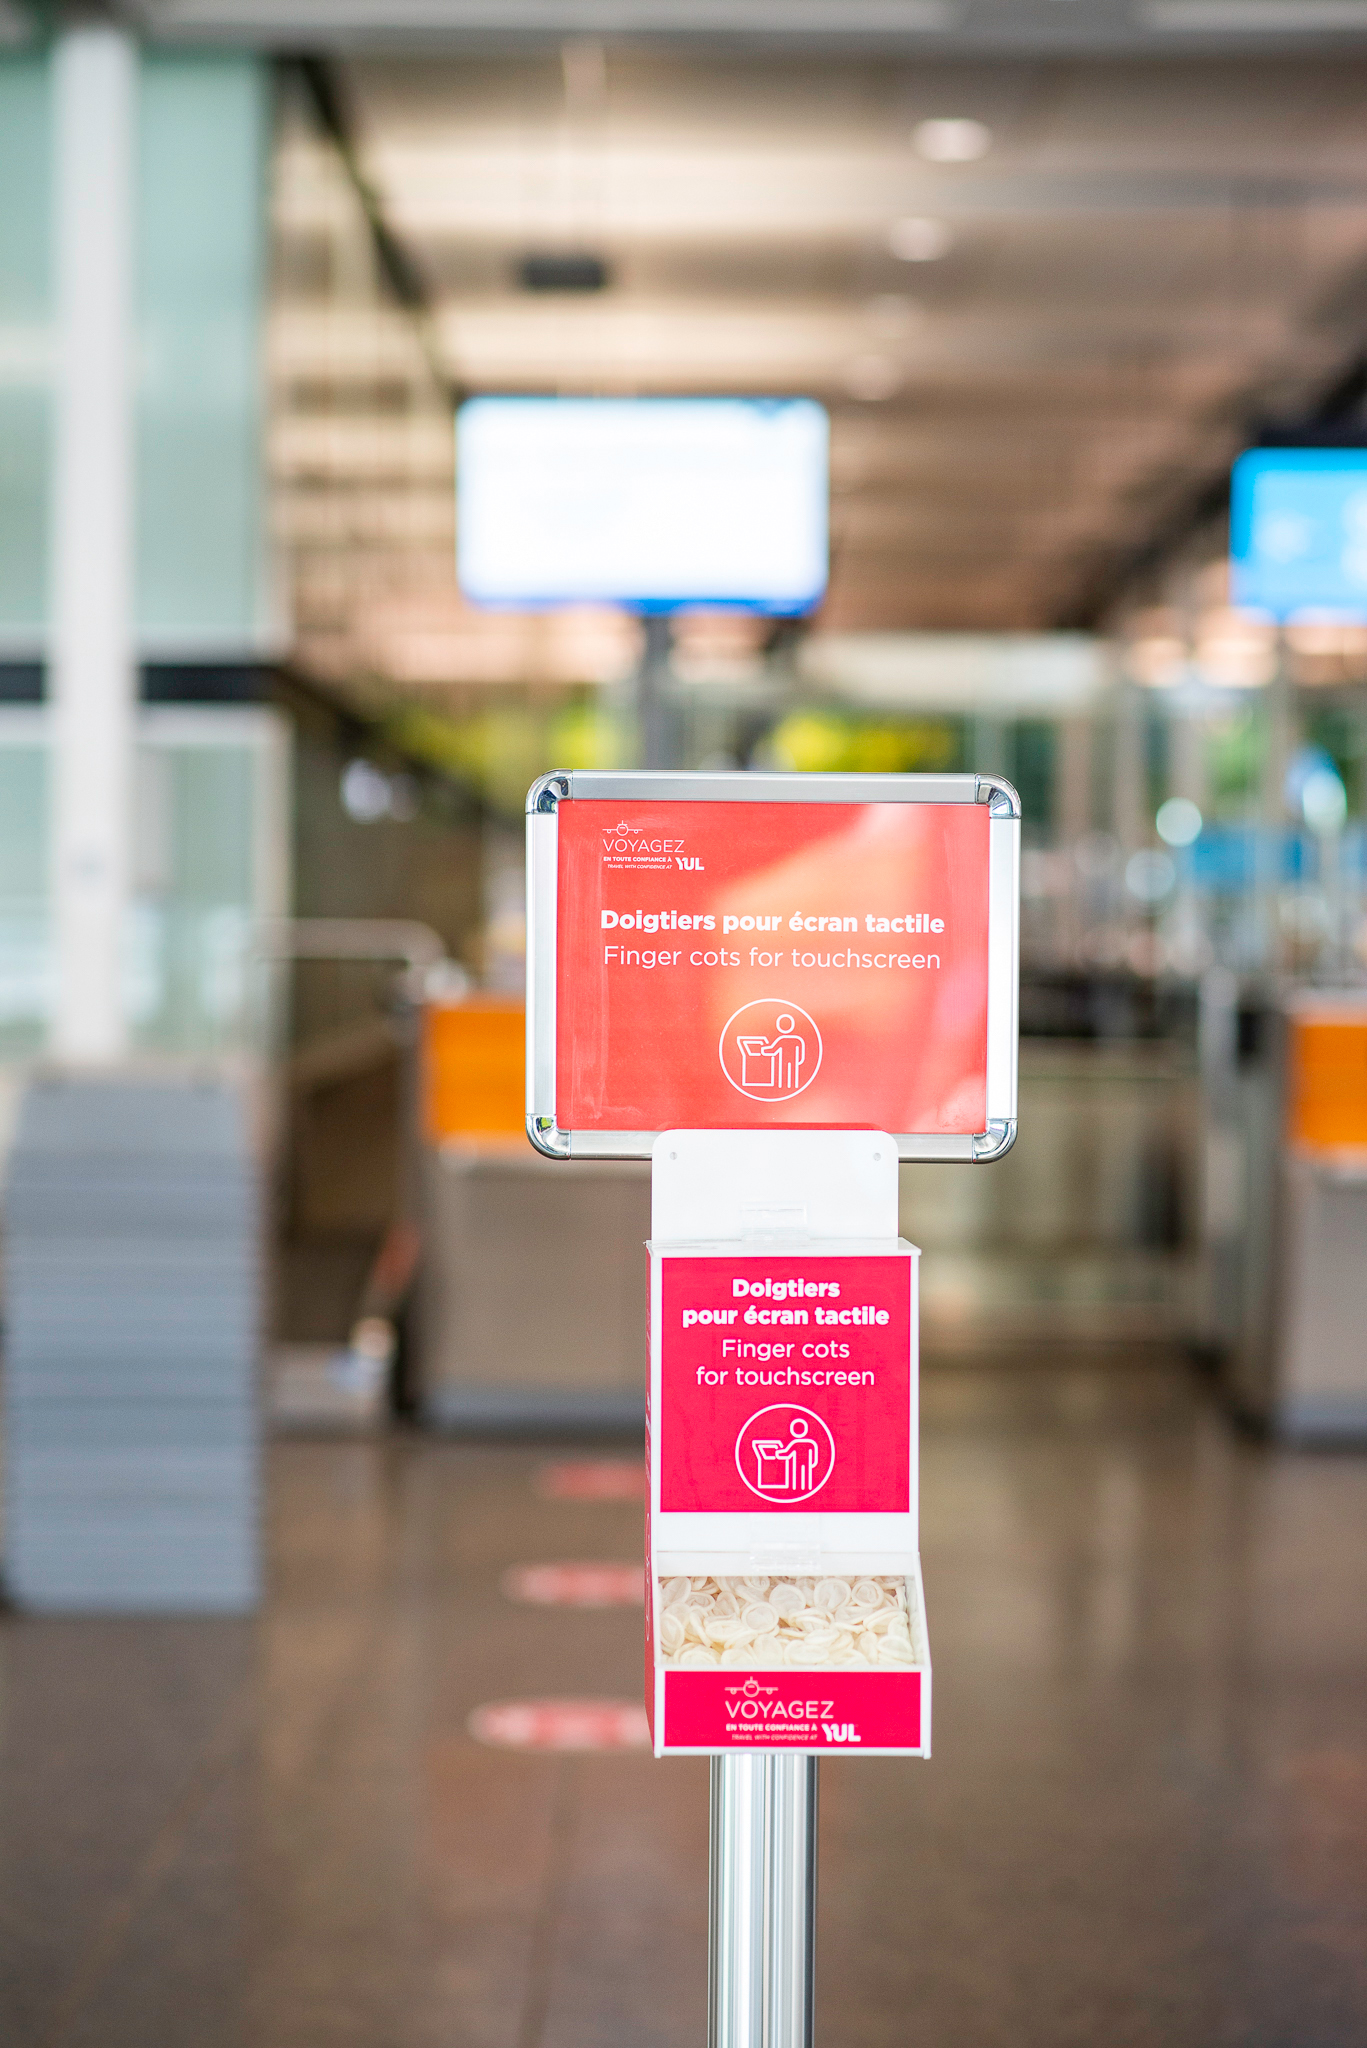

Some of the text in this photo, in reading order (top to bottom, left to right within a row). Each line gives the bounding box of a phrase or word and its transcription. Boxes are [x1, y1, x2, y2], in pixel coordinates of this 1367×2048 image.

[603, 839, 685, 853] VOYAGEZ
[675, 857, 705, 871] YUL
[601, 909, 945, 934] Doigtiers pour écran tactile
[604, 945, 940, 969] Finger cots for touchscreen
[732, 1278, 841, 1301] Doigtiers
[682, 1305, 890, 1328] pour écran tactile
[722, 1339, 850, 1361] Finger cots
[696, 1366, 875, 1386] for touchscreen
[725, 1700, 834, 1719] VOYAGEZ
[726, 1723, 737, 1731] EN
[738, 1723, 764, 1731] TOUTE
[765, 1723, 810, 1731] CONFIANCE
[821, 1723, 861, 1742] YUL
